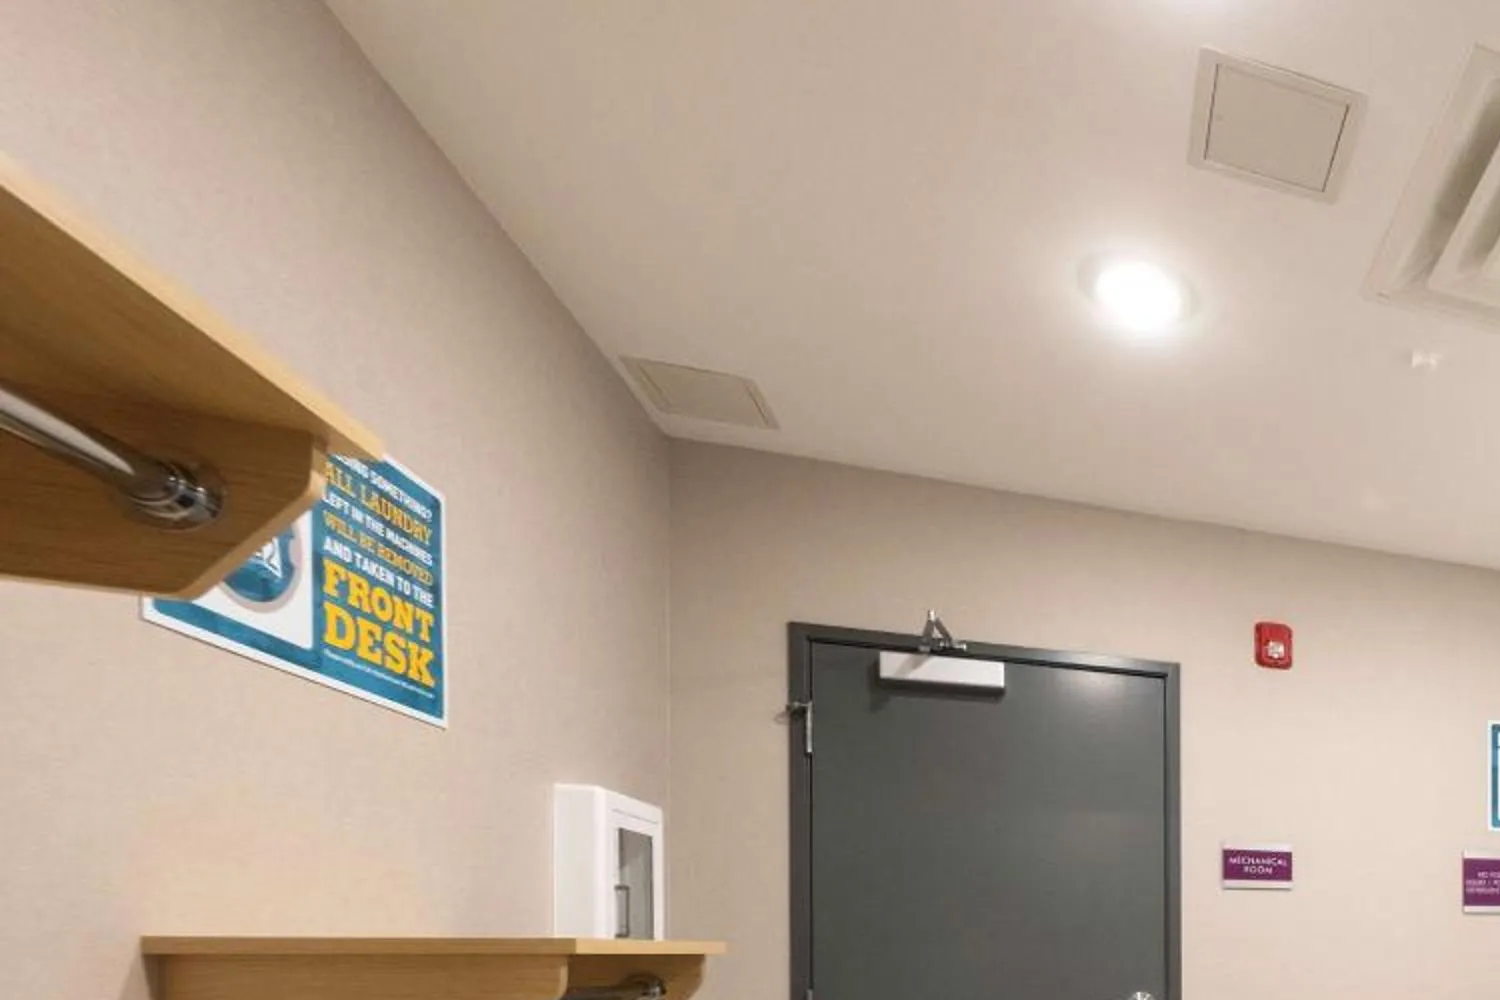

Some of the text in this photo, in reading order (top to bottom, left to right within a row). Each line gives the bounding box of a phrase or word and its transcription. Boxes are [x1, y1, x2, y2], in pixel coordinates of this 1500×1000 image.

[326, 461, 432, 546] ALL LAUNDRY
[370, 469, 433, 522] SOMETHING?
[323, 509, 433, 586] WILL BE REMOVED
[324, 535, 435, 609] AND TAKEN TO THE
[351, 505, 364, 524] IN
[365, 514, 385, 537] THE
[386, 526, 433, 567] MACHINES
[322, 558, 435, 643] FRONT
[322, 600, 436, 689] DESK
